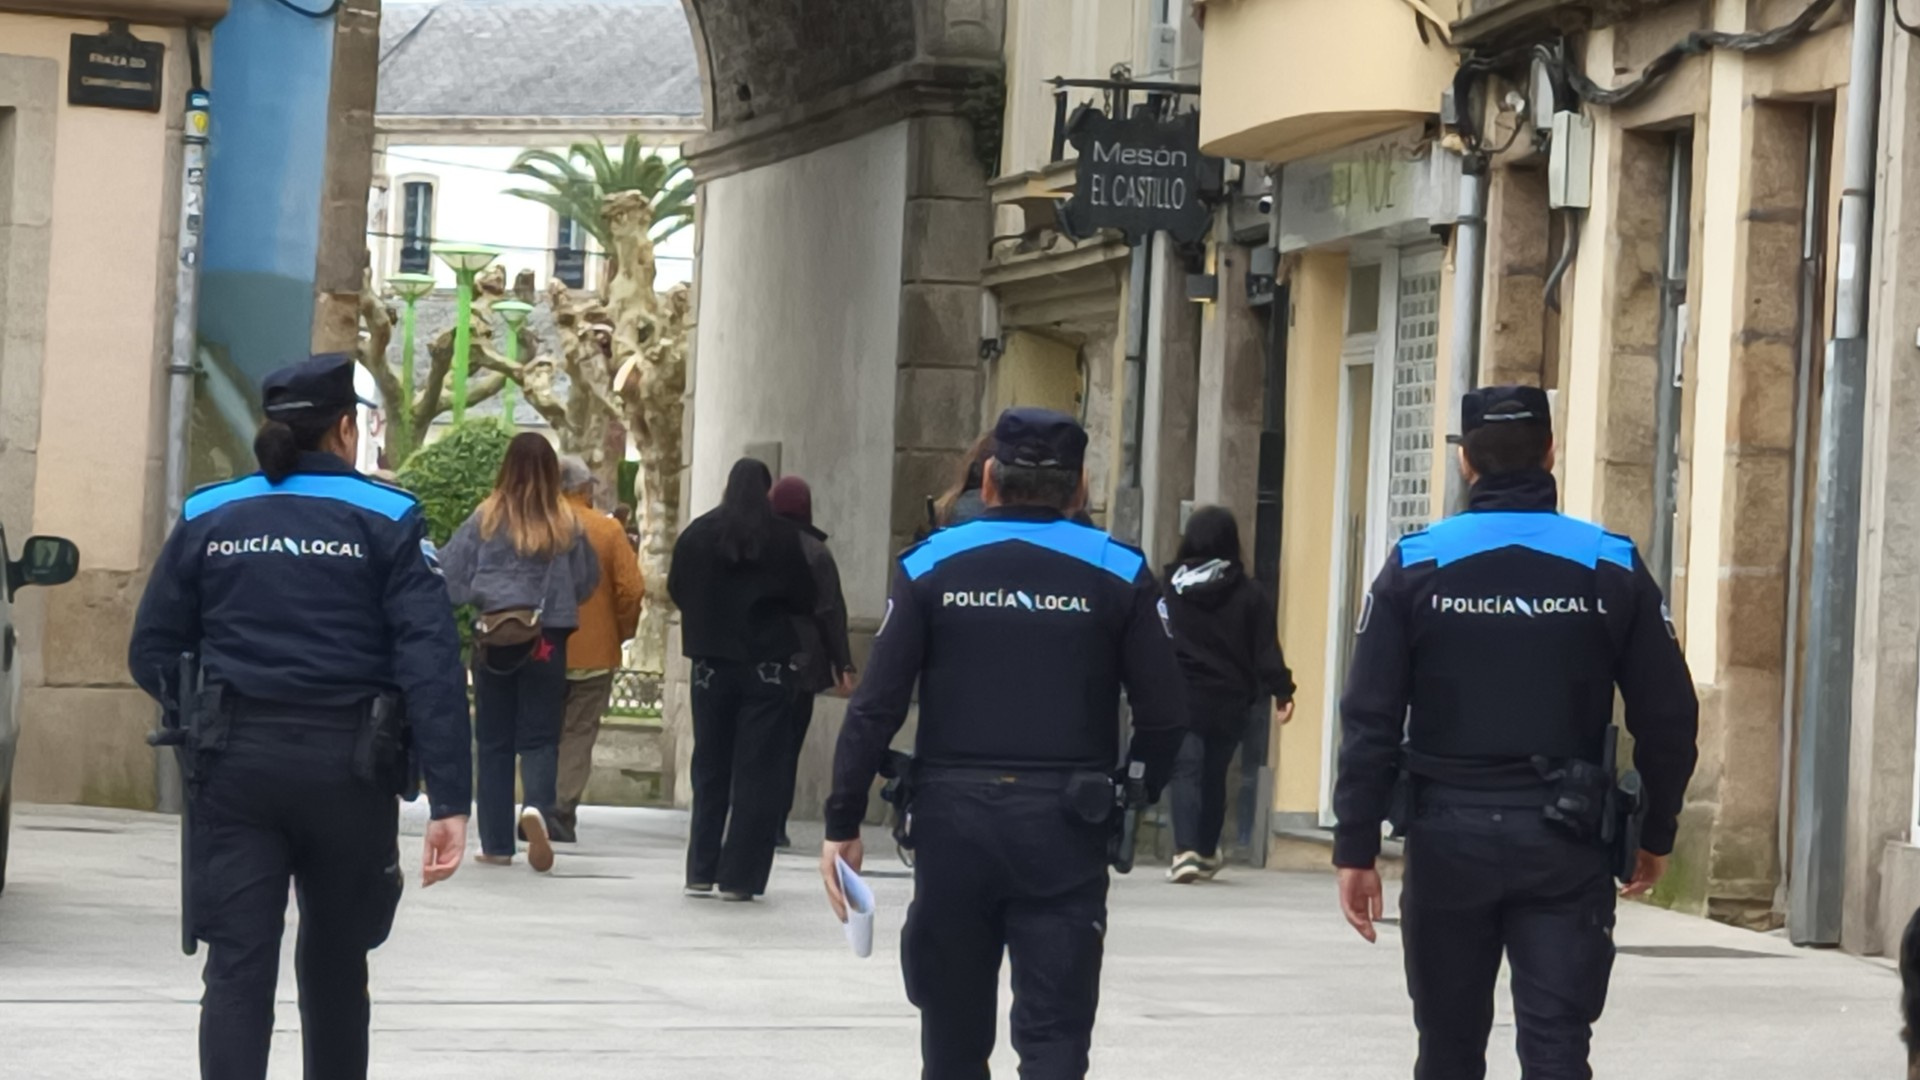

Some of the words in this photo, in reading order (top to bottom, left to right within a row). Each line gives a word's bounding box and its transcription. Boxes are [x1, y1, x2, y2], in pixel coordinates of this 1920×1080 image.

[1092, 140, 1188, 168] Mesón
[1091, 173, 1109, 206] EL
[1112, 174, 1187, 210] CASTILLO
[206, 534, 284, 557] POLICÍA
[301, 539, 364, 558] LOCAL
[942, 588, 1018, 608] POLICÍA
[1035, 594, 1091, 613] LOCAL
[1440, 595, 1515, 614] POLICÍA
[1532, 597, 1588, 614] LOCAL
